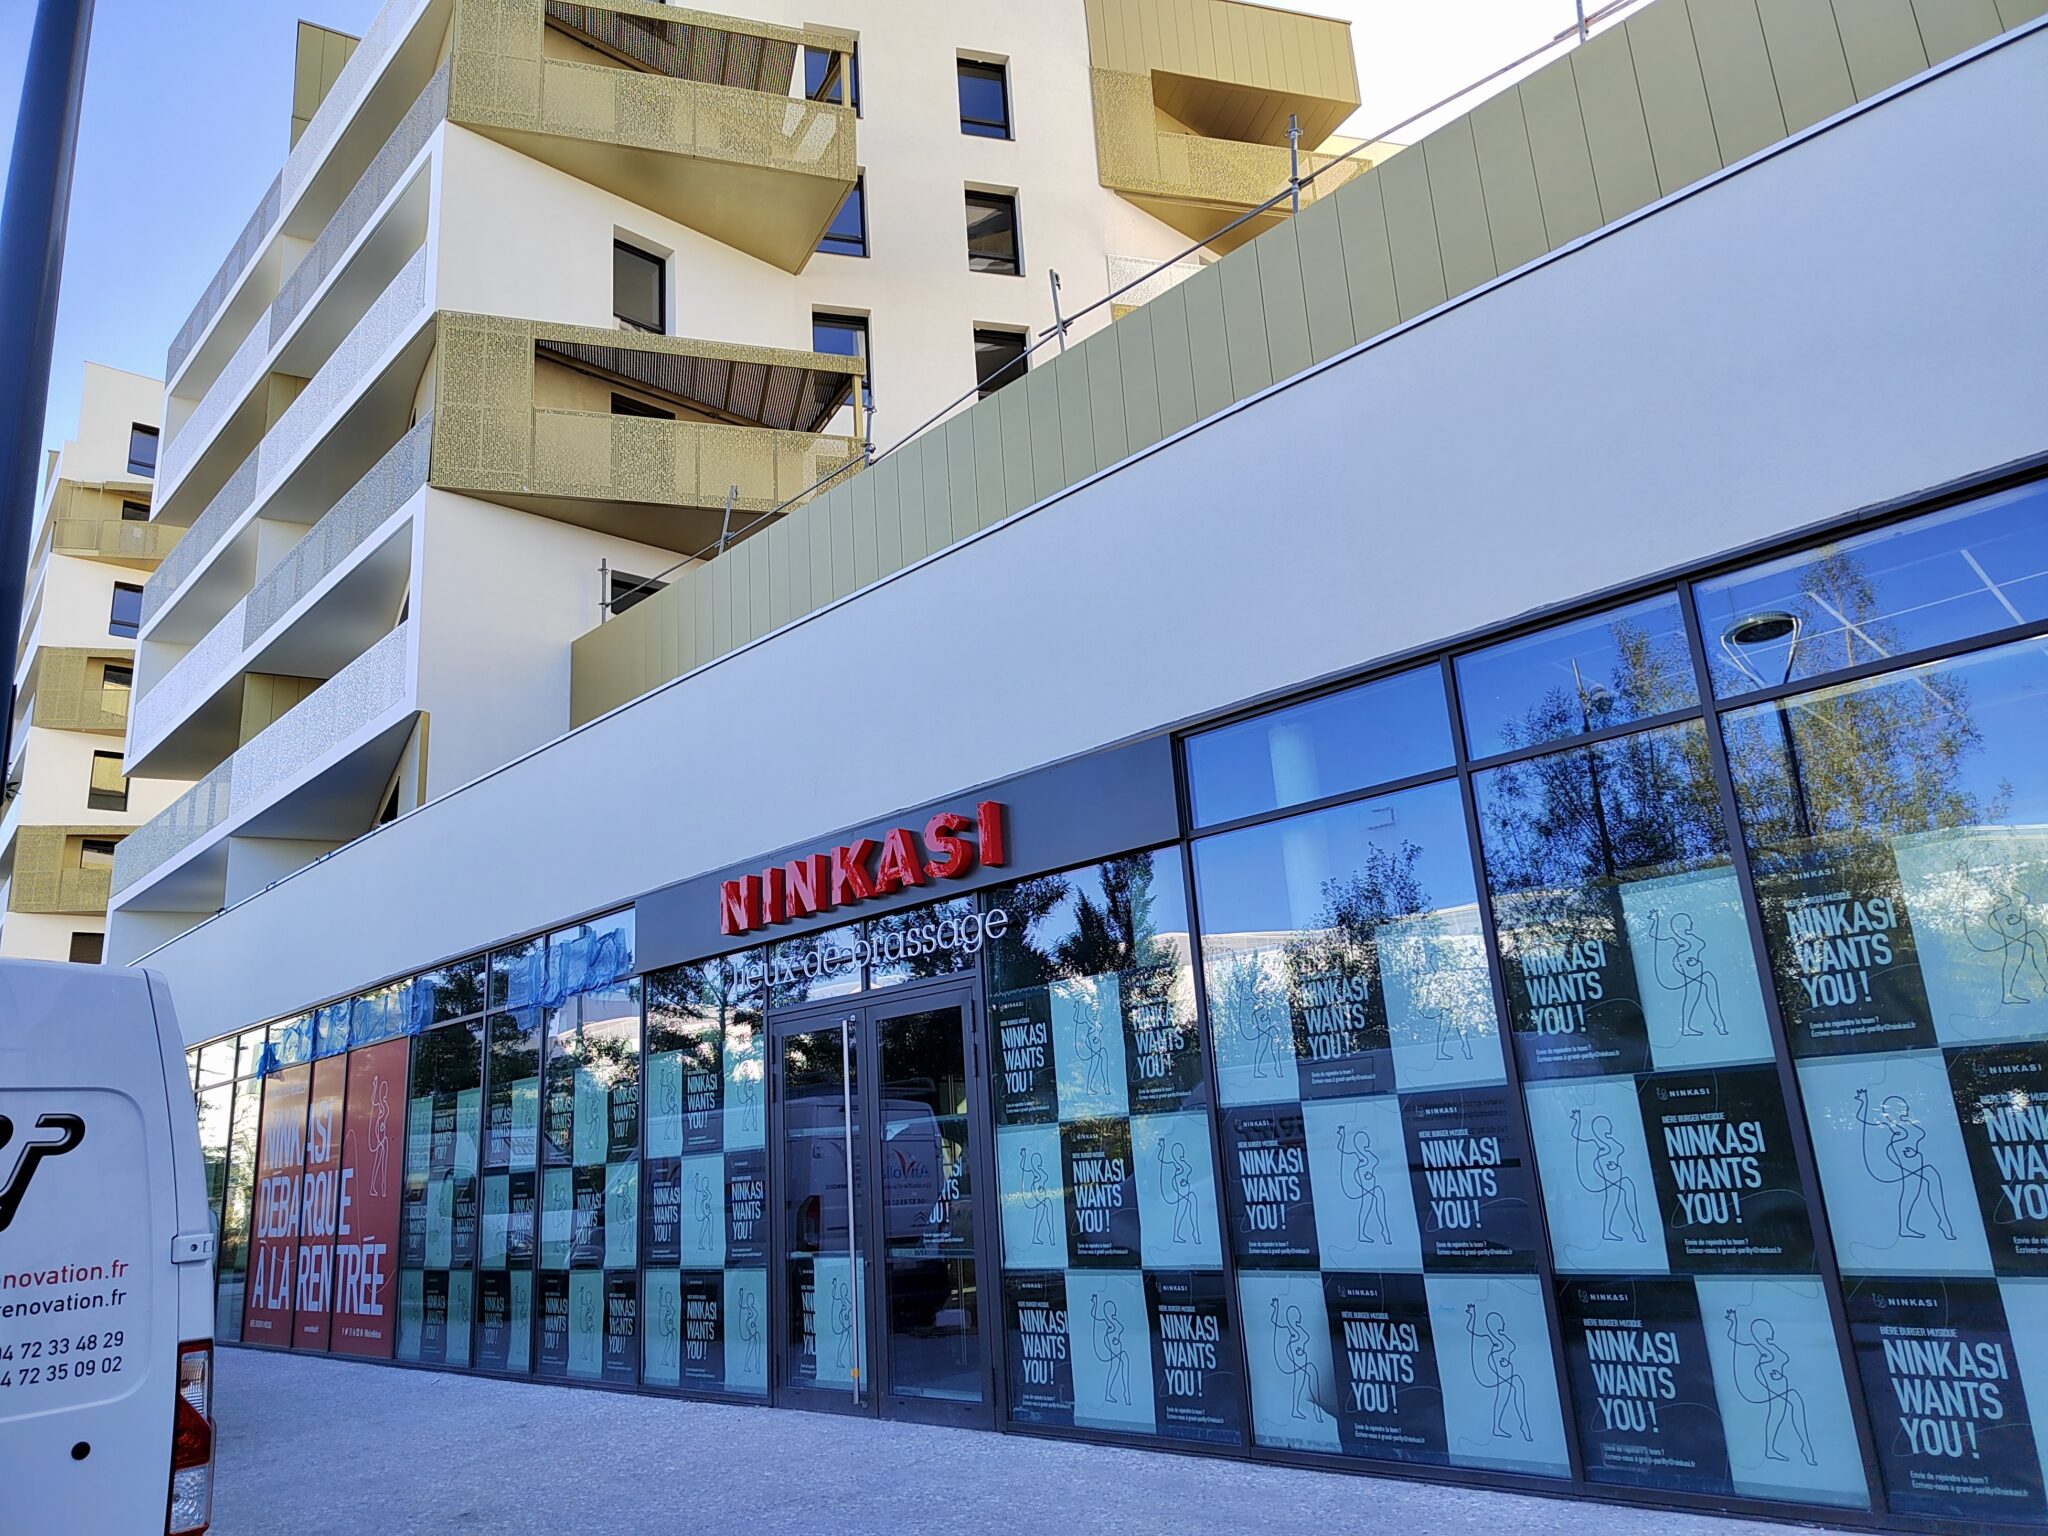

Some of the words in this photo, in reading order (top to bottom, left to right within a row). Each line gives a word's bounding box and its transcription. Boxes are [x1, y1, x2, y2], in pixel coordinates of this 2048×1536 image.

[720, 800, 1004, 936] NINKASI
[1792, 868, 1835, 880] NINKASI
[1786, 896, 1897, 939] NINKASI
[803, 944, 841, 979] de
[850, 907, 1009, 970] brassage
[1794, 933, 1893, 974] WANTS
[1521, 939, 1607, 977] NINKASI
[1302, 975, 1369, 1008] NINKASI
[1525, 971, 1603, 1007] WANTS
[1303, 1002, 1366, 1035] WANTS
[1001, 1022, 1047, 1050] NINKASI
[1003, 1046, 1045, 1071] WANTS
[1989, 1064, 2042, 1074] NINKASI
[688, 1073, 718, 1093] NINKASI
[1669, 1088, 1710, 1097] NINKASI
[688, 1092, 715, 1112] WANTS
[263, 1100, 333, 1170] NINKASI
[1663, 1121, 1766, 1157] NINKASI
[1239, 1147, 1304, 1176] NINKASI
[1420, 1136, 1501, 1168] NINKASI
[1073, 1159, 1125, 1183] NINKASI
[1425, 1168, 1498, 1198] WANTS
[1669, 1156, 1762, 1190] WANTS
[257, 1166, 354, 1239] DÉBARQUE
[653, 1186, 680, 1206] NINKASI
[732, 1181, 763, 1201] NINKASI
[1074, 1183, 1122, 1208] WANTS
[1242, 1175, 1300, 1202] WANTS
[653, 1205, 678, 1224] WANTS
[732, 1201, 761, 1220] WANTS
[0, 1259, 129, 1290] novation.fr
[251, 1239, 266, 1309] À
[296, 1235, 387, 1316] RENTRÉE
[687, 1301, 717, 1320] NINKASI
[1888, 1298, 1938, 1307] NINKASI
[687, 1321, 715, 1340] WANTS
[1019, 1309, 1069, 1334] NINKASI
[1160, 1314, 1219, 1341] NINKASI
[21, 1341, 42, 1360] 72
[48, 1337, 70, 1356] 33
[76, 1334, 97, 1352] 48
[103, 1331, 124, 1349] 29
[1021, 1334, 1066, 1360] WANTS
[1343, 1321, 1419, 1352] NINKASI
[1585, 1329, 1680, 1365] NINKASI
[1163, 1341, 1216, 1369] WANTS
[1347, 1351, 1414, 1384] WANTS
[1882, 1339, 2009, 1380] NINKASI
[20, 1367, 40, 1386] 72
[46, 1363, 69, 1382] 35
[74, 1359, 96, 1378] 09
[101, 1356, 122, 1373] 02
[1591, 1363, 1677, 1400] WANTS
[1890, 1377, 2004, 1420] WANTS
